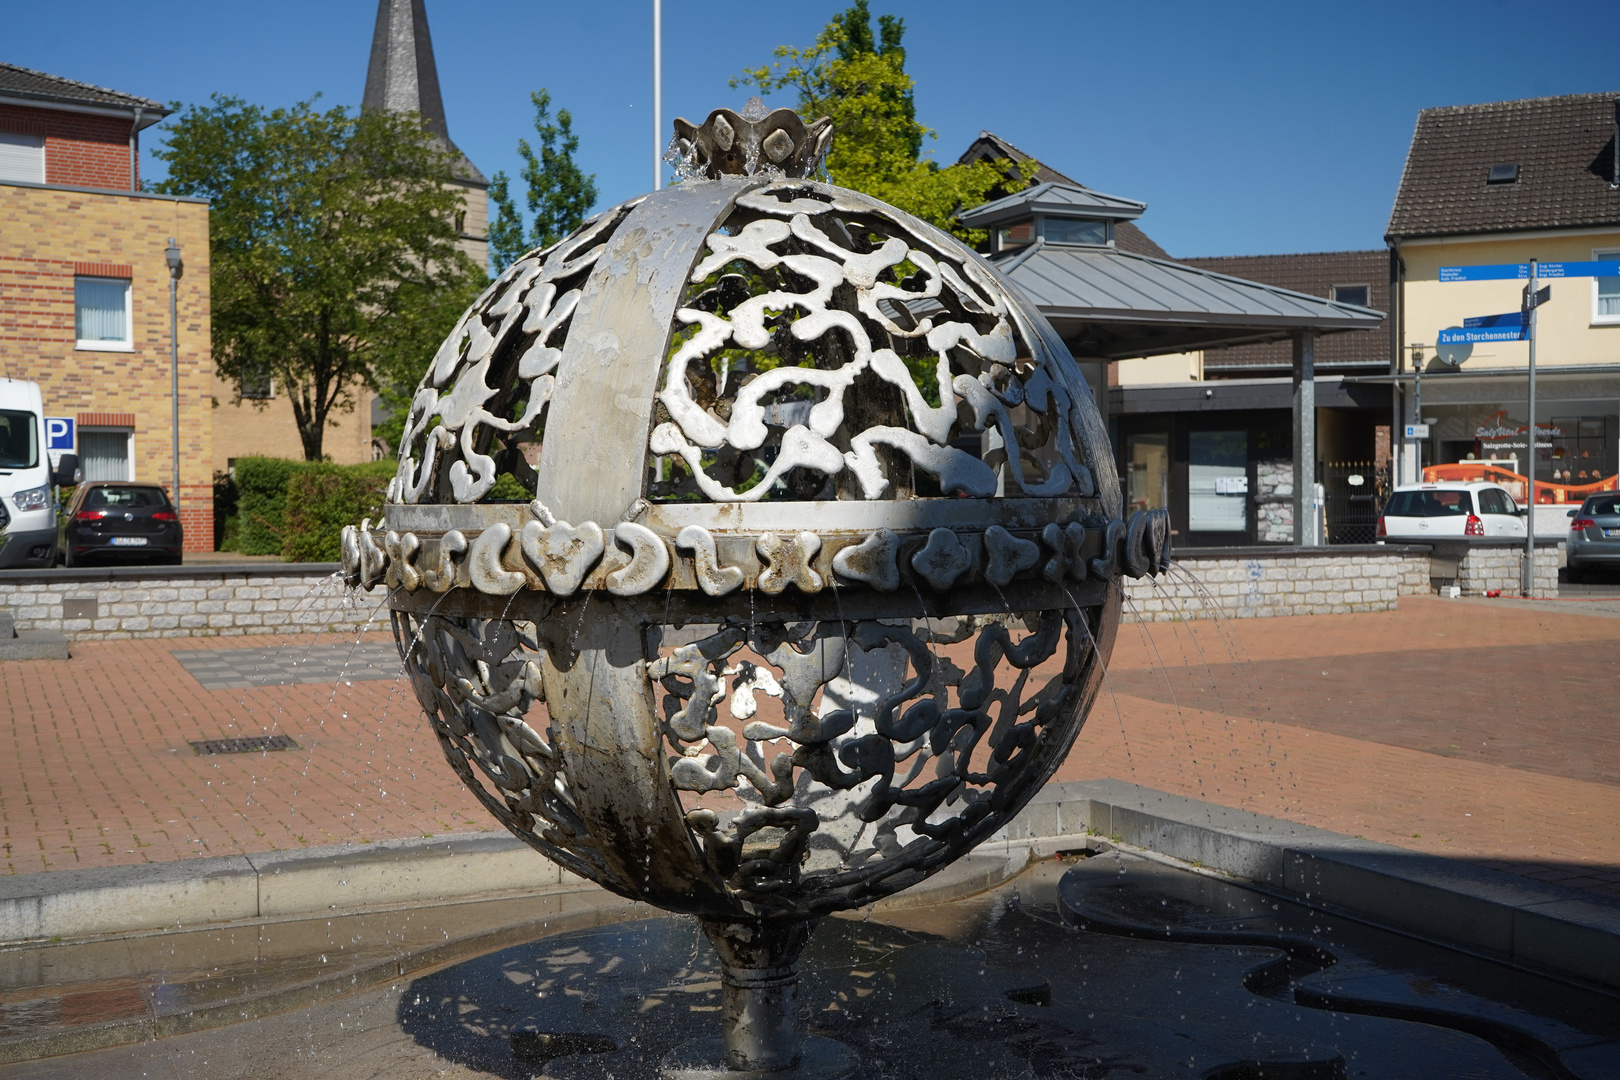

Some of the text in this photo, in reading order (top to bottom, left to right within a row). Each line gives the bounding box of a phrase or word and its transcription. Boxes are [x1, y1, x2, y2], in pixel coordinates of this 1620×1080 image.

[1442, 334, 1450, 342] Zu
[1452, 333, 1465, 341] den
[47, 419, 68, 448] P
[1483, 442, 1552, 450] Salzgrotte-Sole-ellness
